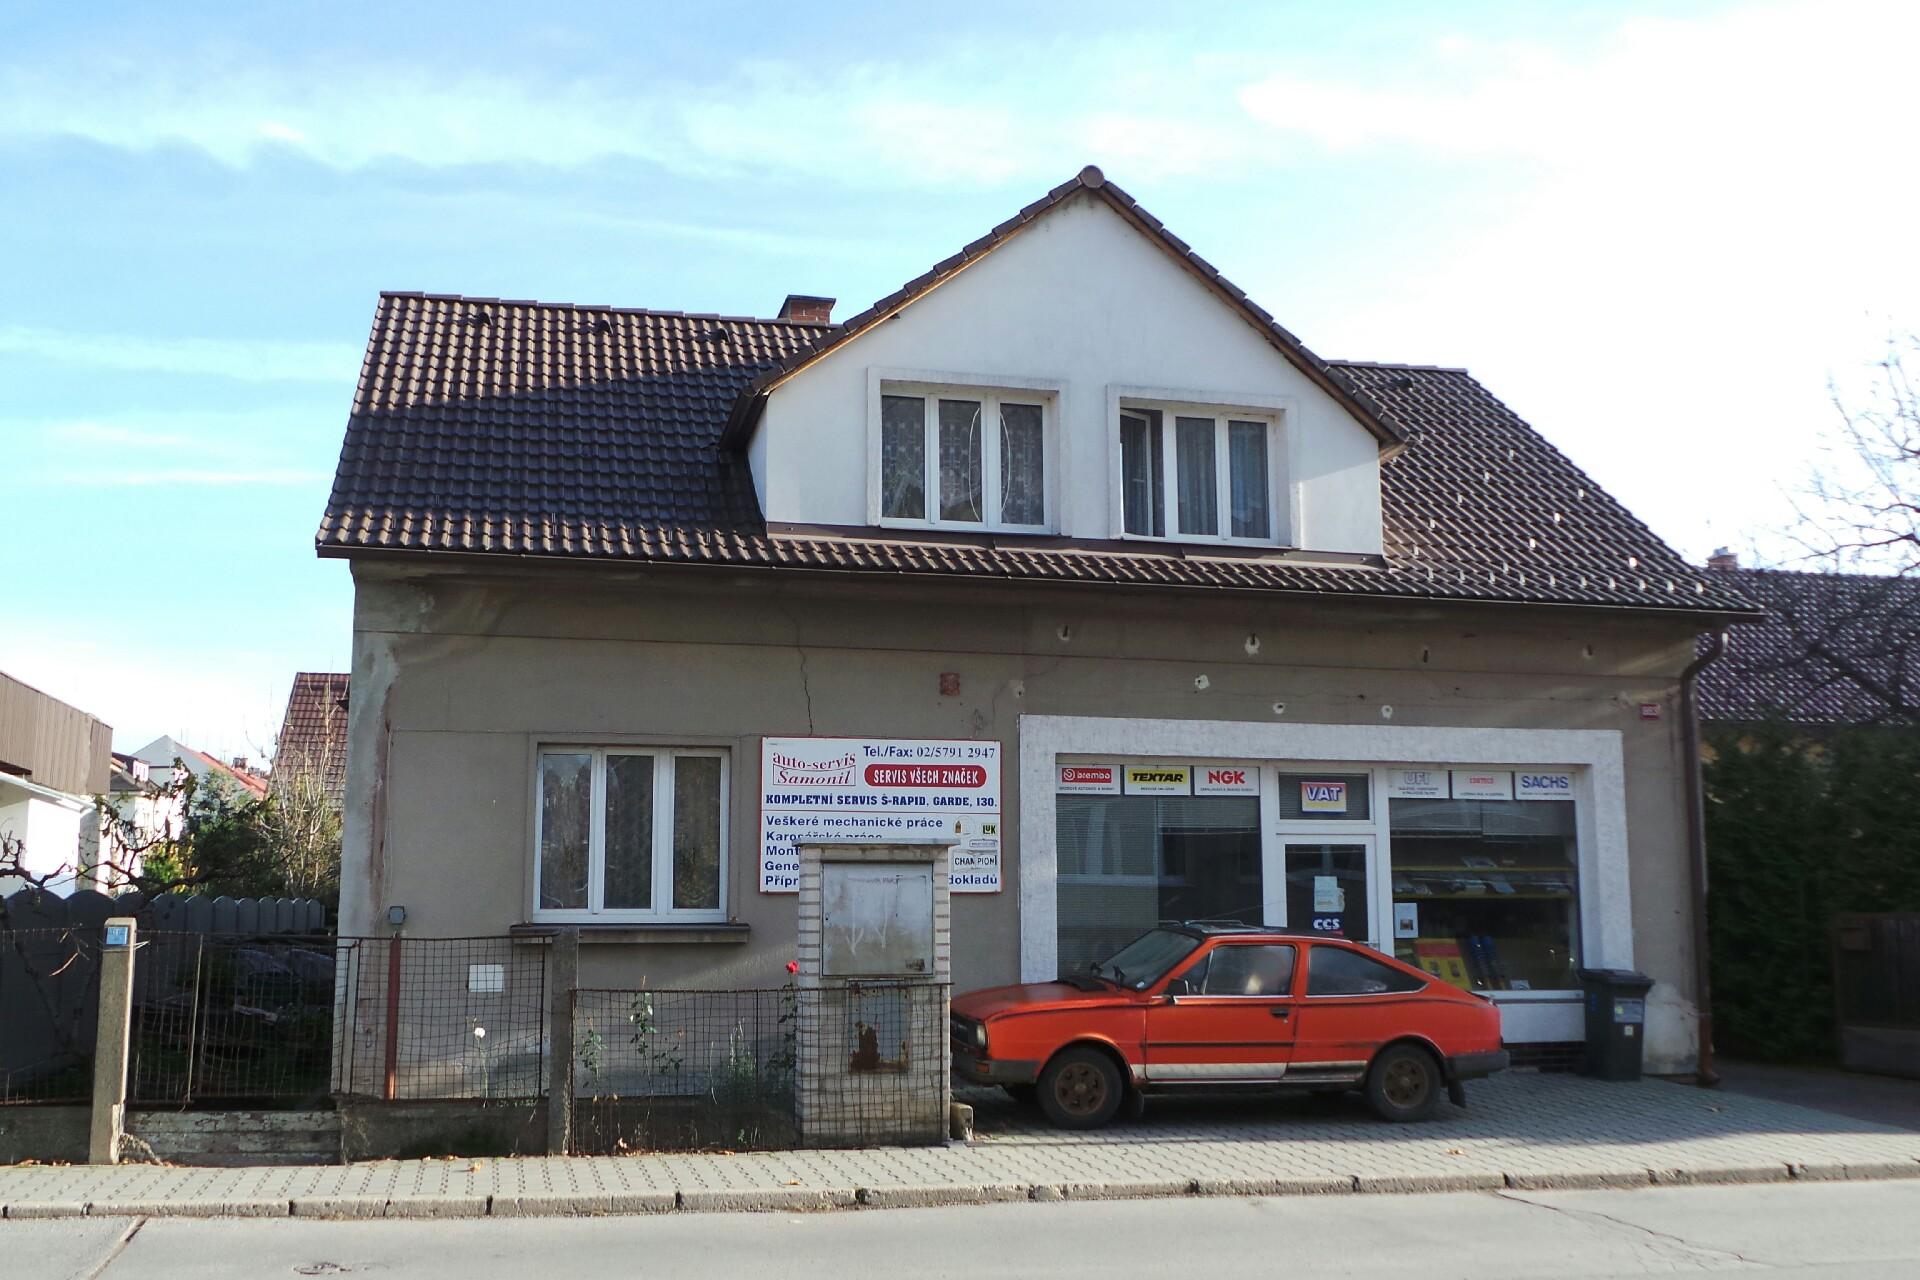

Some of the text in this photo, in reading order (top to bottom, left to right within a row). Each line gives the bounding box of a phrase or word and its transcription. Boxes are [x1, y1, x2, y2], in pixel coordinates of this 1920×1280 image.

[917, 746, 962, 758] 02/5791
[967, 747, 995, 758] 2947
[773, 752, 856, 770] auto-servis
[777, 767, 851, 785] Šamonil
[873, 766, 979, 784] SERVIS VŠECH ZNAČEK
[1076, 770, 1111, 779] brembo
[1132, 772, 1184, 782] TEXTAR
[1208, 770, 1246, 784] NGK
[1521, 775, 1569, 789] SACHS
[766, 793, 833, 805] KOMPLETNÍ
[837, 795, 878, 805] SERVIS
[933, 796, 972, 807] GARDE,
[1307, 786, 1343, 801] VAT
[766, 815, 943, 829] Veškeré mechanické práce
[766, 845, 800, 856] Mont
[765, 861, 799, 871] Gene
[765, 875, 799, 887] Přípr
[1313, 918, 1340, 930] CCS
